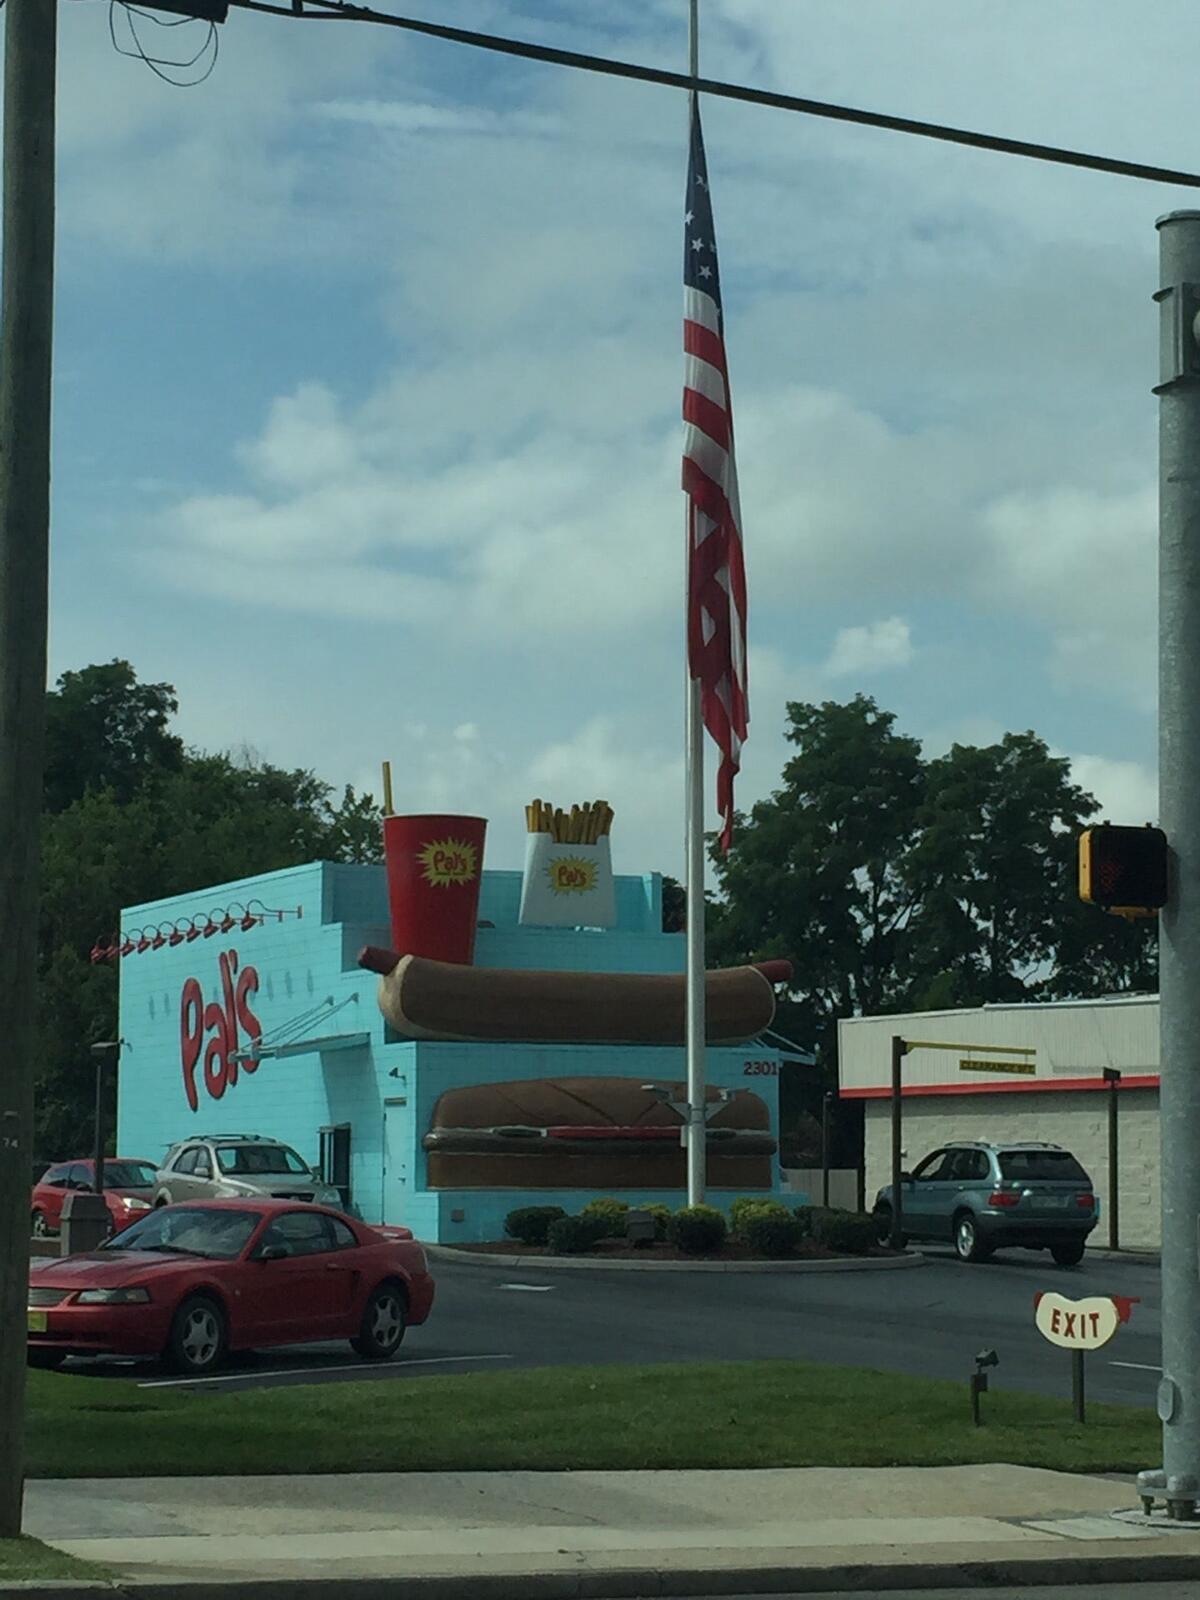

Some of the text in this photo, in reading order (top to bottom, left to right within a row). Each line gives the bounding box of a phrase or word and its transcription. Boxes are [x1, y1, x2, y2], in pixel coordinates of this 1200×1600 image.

[433, 850, 467, 872] Pal's
[558, 866, 586, 886] Pal's
[181, 949, 262, 1113] Pal's
[743, 1061, 777, 1076] 2301
[1051, 1308, 1099, 1339] EXIT
